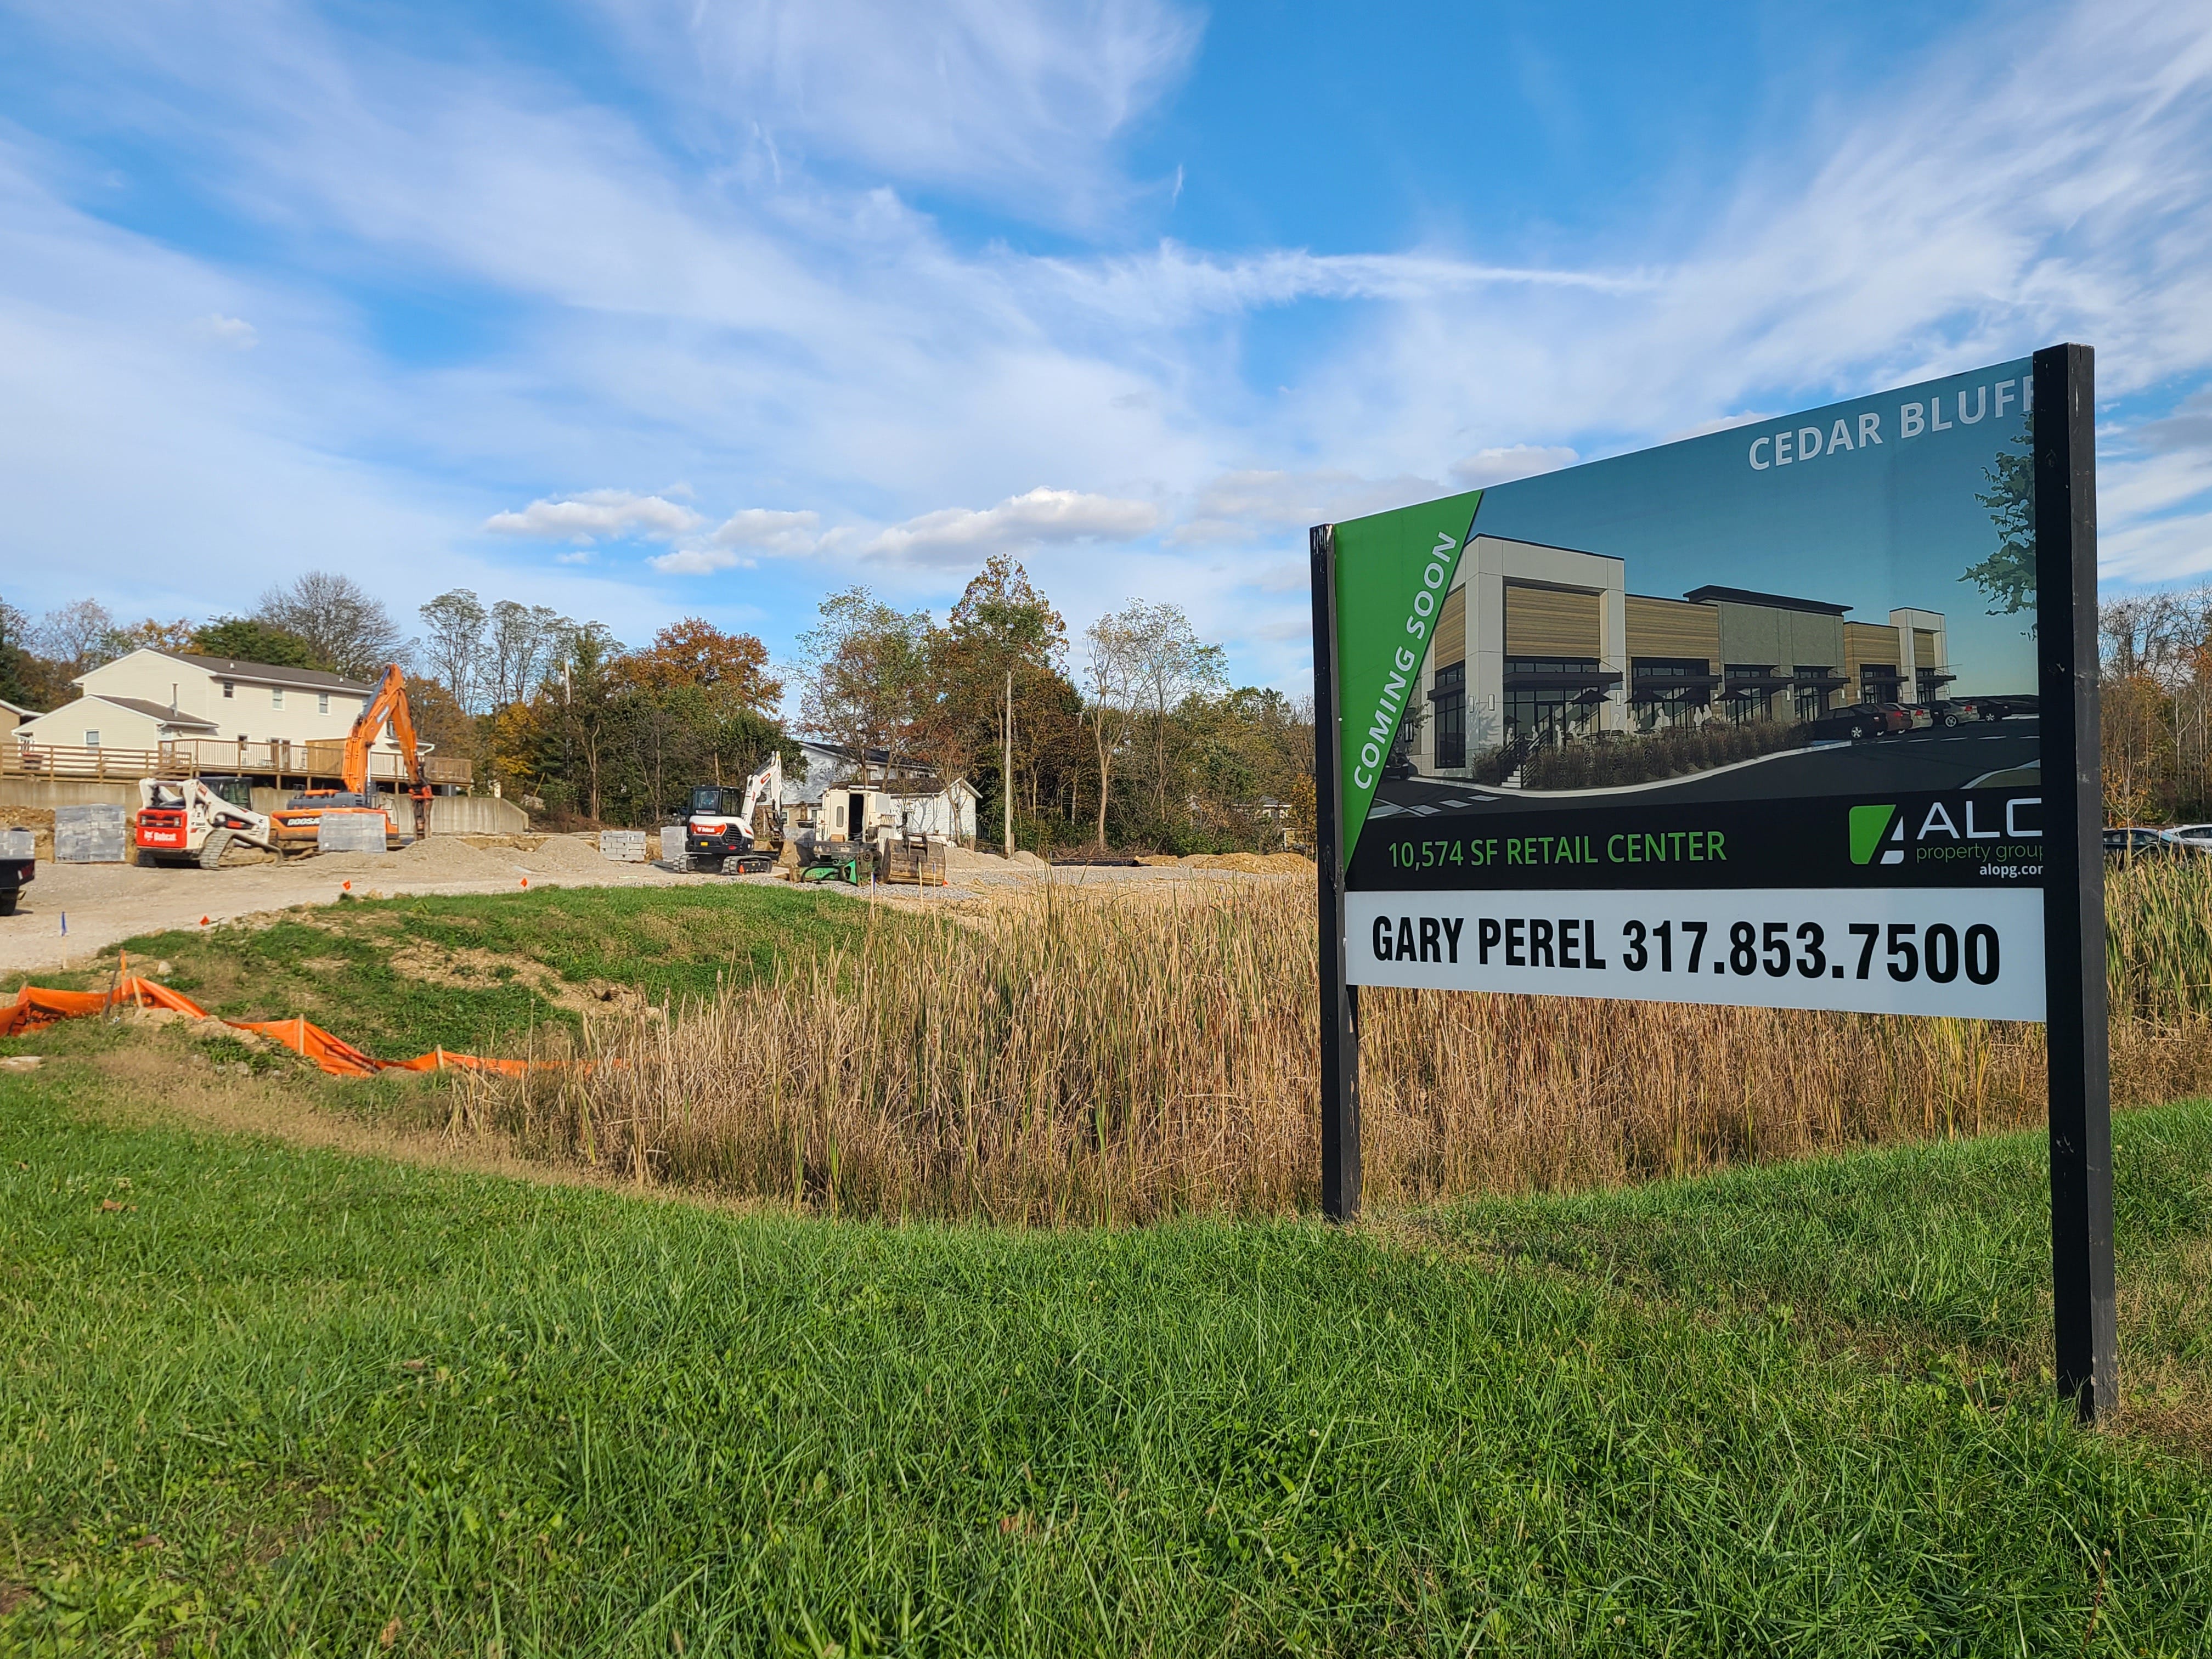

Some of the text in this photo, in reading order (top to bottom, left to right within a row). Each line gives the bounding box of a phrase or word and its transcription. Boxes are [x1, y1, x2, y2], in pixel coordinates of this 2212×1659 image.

[1748, 413, 1883, 470] CEDAR
[1354, 531, 1457, 789] COMING SOON
[287, 817, 320, 826] DOOSA
[1388, 831, 1728, 871] 10,574 SF RETAIL CENTER
[1916, 843, 1990, 864] property
[1373, 916, 2001, 985] GARY PEREL 317.853.7500
